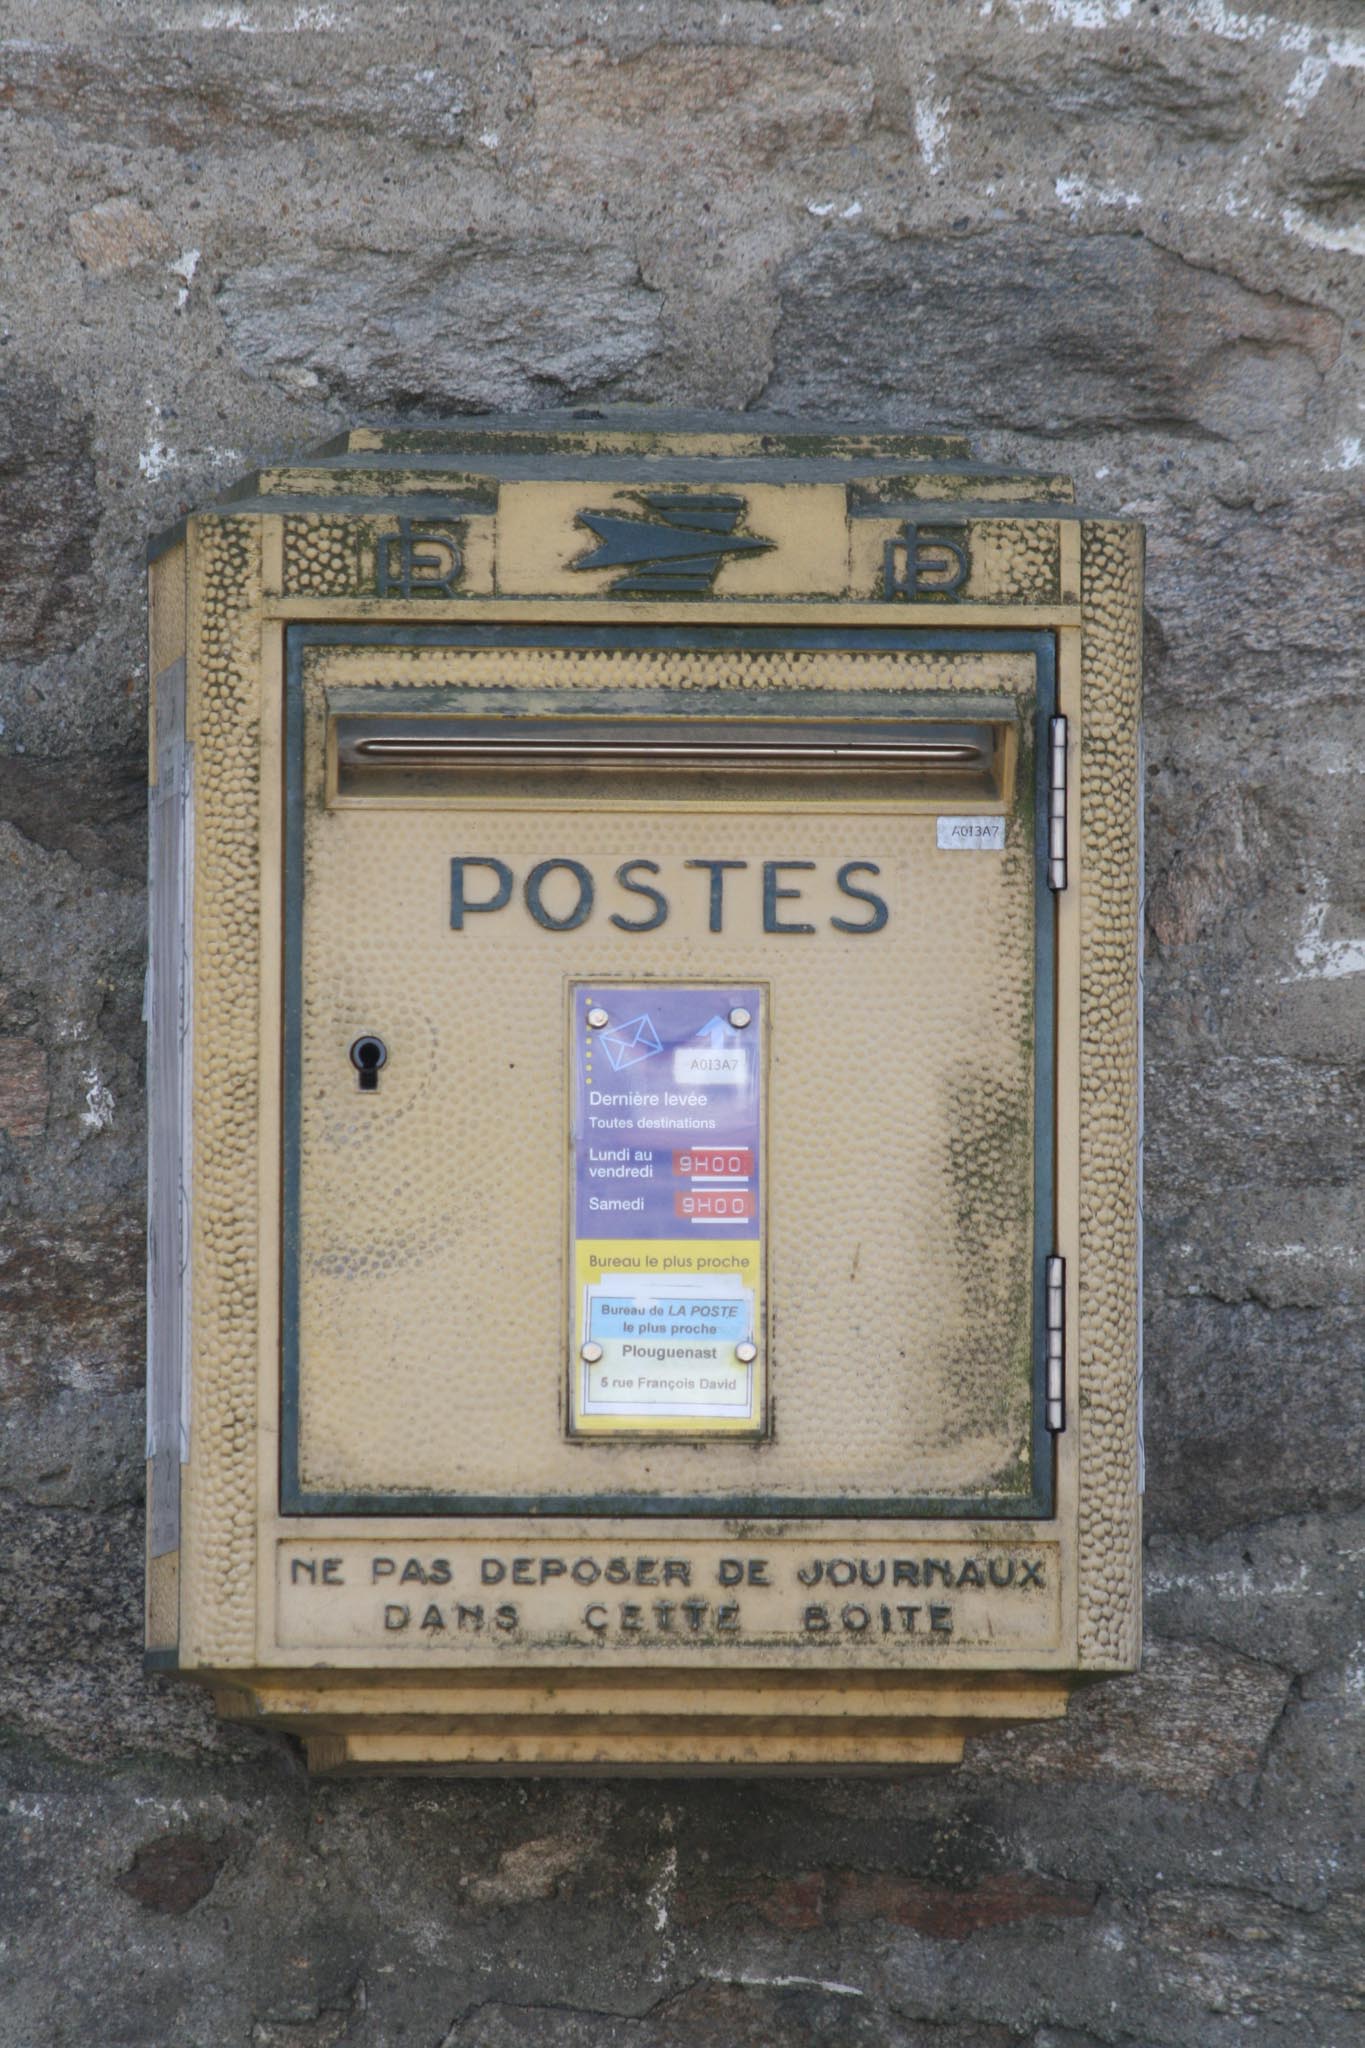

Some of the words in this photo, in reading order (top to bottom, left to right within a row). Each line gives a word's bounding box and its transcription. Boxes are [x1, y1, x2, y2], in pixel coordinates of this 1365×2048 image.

[449, 856, 889, 933] POSTES
[589, 1091, 659, 1106] Dernière
[664, 1091, 708, 1106] levée
[588, 1116, 634, 1129] Toutes
[637, 1116, 716, 1129] destinations
[589, 1148, 630, 1161] Lundi
[634, 1151, 653, 1161] au
[589, 1165, 653, 1178] vendredi
[588, 1197, 645, 1211] Samedi
[589, 1254, 640, 1267] Bureau
[646, 1255, 658, 1267] le
[663, 1255, 693, 1270] plus
[697, 1256, 750, 1270] proche
[601, 1305, 645, 1316] Bureau
[650, 1305, 664, 1316] de
[668, 1306, 687, 1317] LA
[691, 1306, 738, 1317] POSTE
[623, 1322, 634, 1332] le
[638, 1323, 666, 1335] plus
[671, 1323, 717, 1336] proche
[622, 1344, 717, 1360] Plouguenast
[600, 1377, 608, 1388] 5
[612, 1379, 634, 1388] rue
[638, 1377, 695, 1390] François
[700, 1378, 737, 1390] David
[291, 1558, 344, 1585] NE
[372, 1557, 453, 1585] PAS
[481, 1557, 692, 1586] DEPOSER
[718, 1558, 771, 1586] DE
[798, 1557, 1045, 1587] JOURNAUX
[384, 1604, 519, 1631] DANS
[585, 1604, 741, 1632] CETTE
[804, 1604, 953, 1632] BOITE
